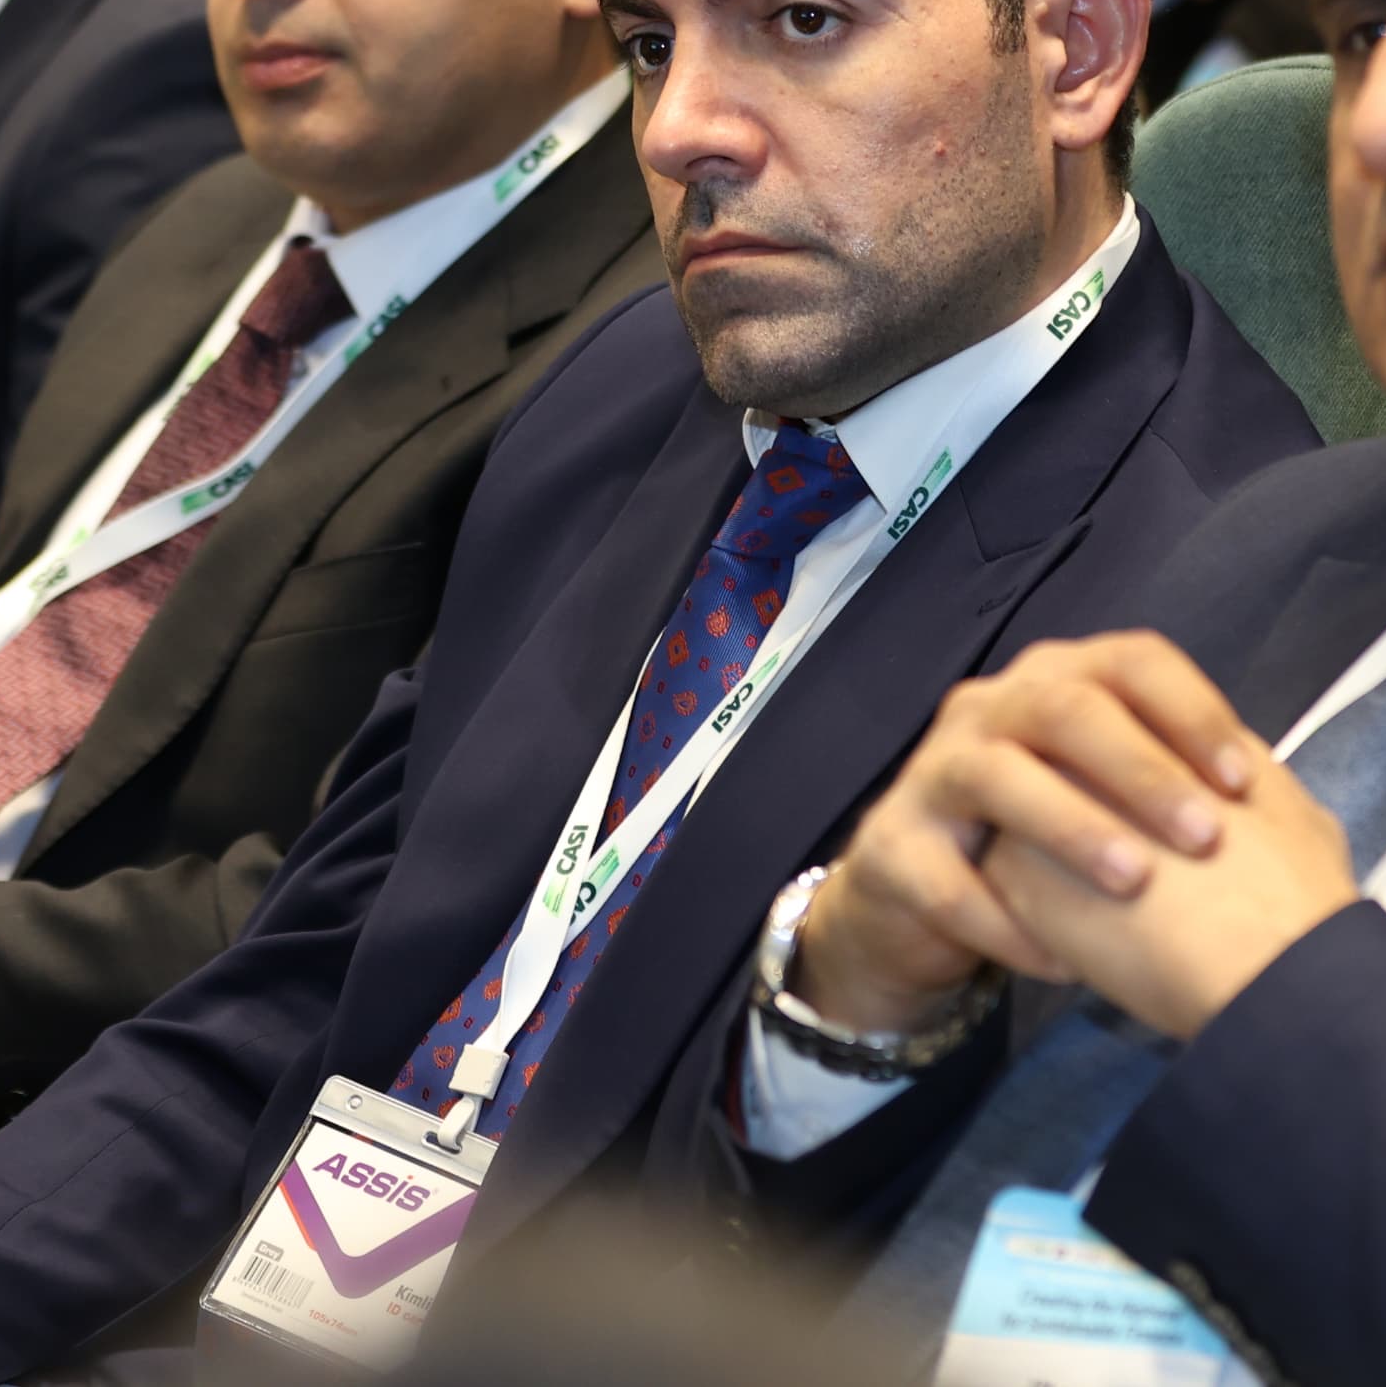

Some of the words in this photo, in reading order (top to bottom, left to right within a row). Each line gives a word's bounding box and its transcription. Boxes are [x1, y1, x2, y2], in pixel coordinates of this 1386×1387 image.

[1046, 290, 1091, 342] CASI
[887, 486, 929, 541] CASI
[711, 682, 754, 733] CASI
[556, 825, 589, 875] CASI
[570, 881, 597, 926] CA
[395, 1285, 433, 1311] Kimli
